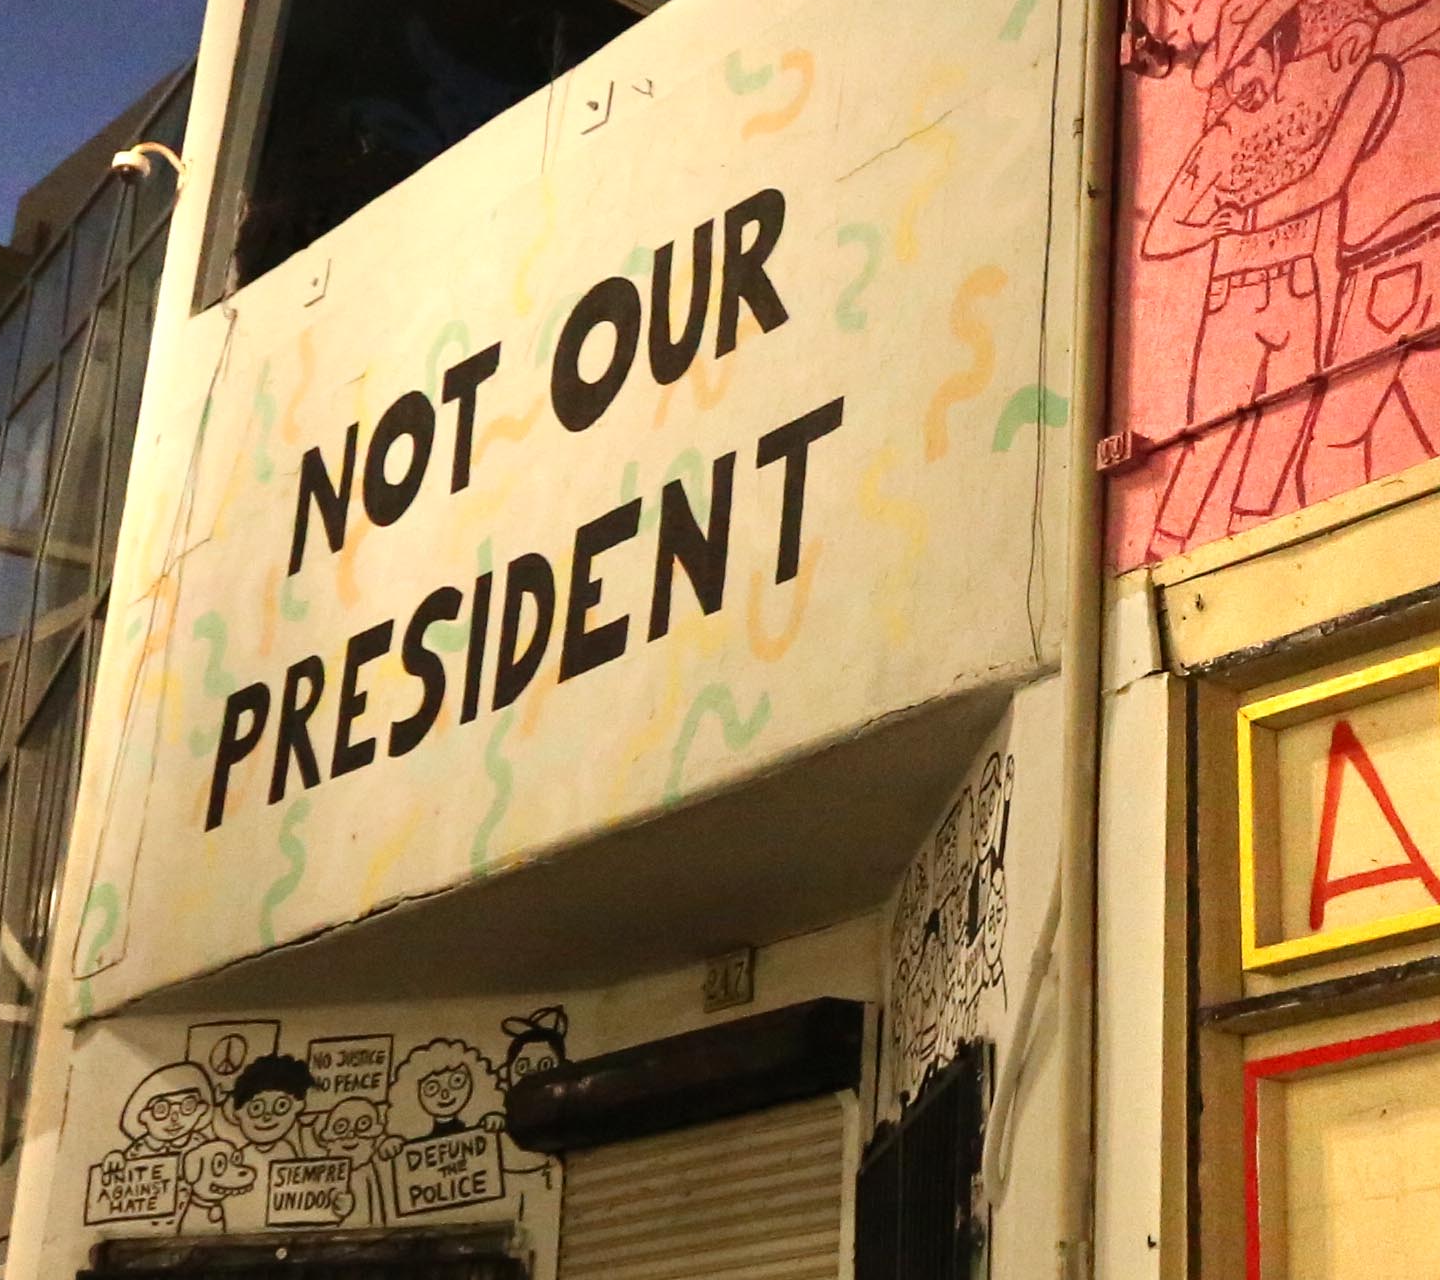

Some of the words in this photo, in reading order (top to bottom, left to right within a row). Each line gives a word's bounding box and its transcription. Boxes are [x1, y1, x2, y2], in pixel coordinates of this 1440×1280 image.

[286, 340, 502, 577] NOT
[550, 187, 790, 433] OUR
[204, 396, 845, 834] PRESIDENT
[313, 1051, 332, 1069] NO
[336, 1049, 386, 1068] JUSTICE
[334, 1072, 383, 1094] PEACE
[405, 1136, 487, 1171] DEFUND
[101, 1164, 164, 1187] UNITE
[274, 1162, 347, 1188] SIEMPRE
[437, 1159, 467, 1178] THE
[97, 1179, 171, 1203] AGAINST
[273, 1187, 336, 1211] UNIDOS
[410, 1171, 488, 1207] POLICE
[109, 1196, 157, 1214] HATE
